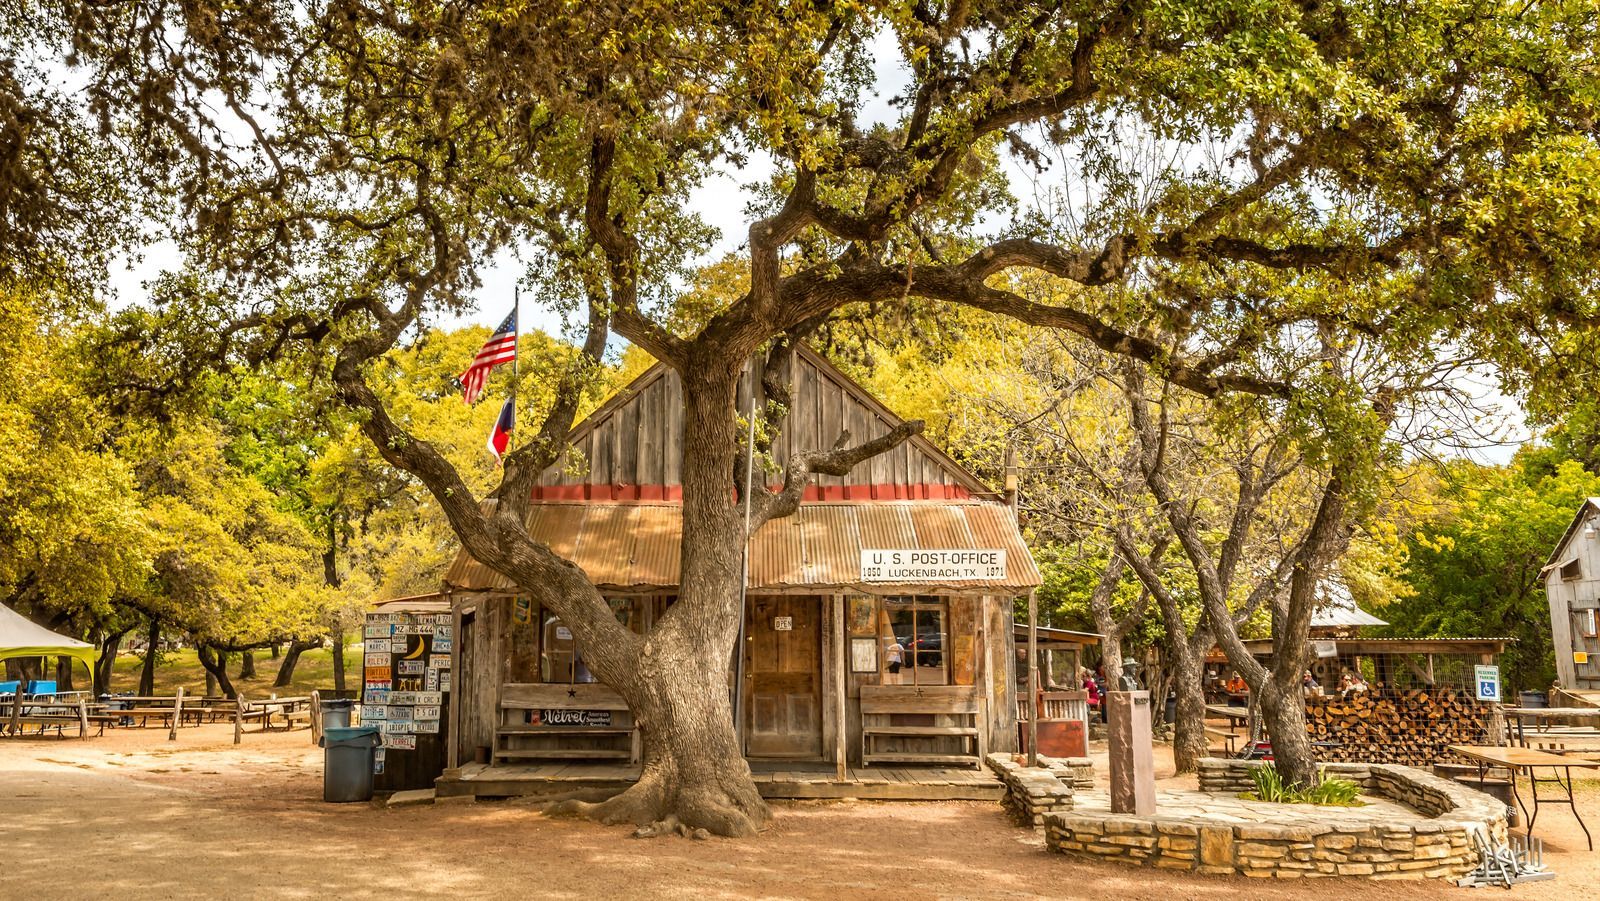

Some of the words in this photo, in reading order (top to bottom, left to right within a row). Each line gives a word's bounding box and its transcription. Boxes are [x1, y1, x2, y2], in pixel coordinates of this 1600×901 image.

[873, 553, 886, 565] U.
[892, 553, 905, 565] S.
[911, 553, 997, 565] POST-OFFICE
[863, 567, 881, 577] 1850
[986, 567, 1004, 577] 1971
[395, 625, 404, 633] MZ
[408, 625, 418, 633] MG
[420, 625, 433, 633] 444
[776, 620, 792, 628] OPEN
[543, 709, 586, 724] Velvet
